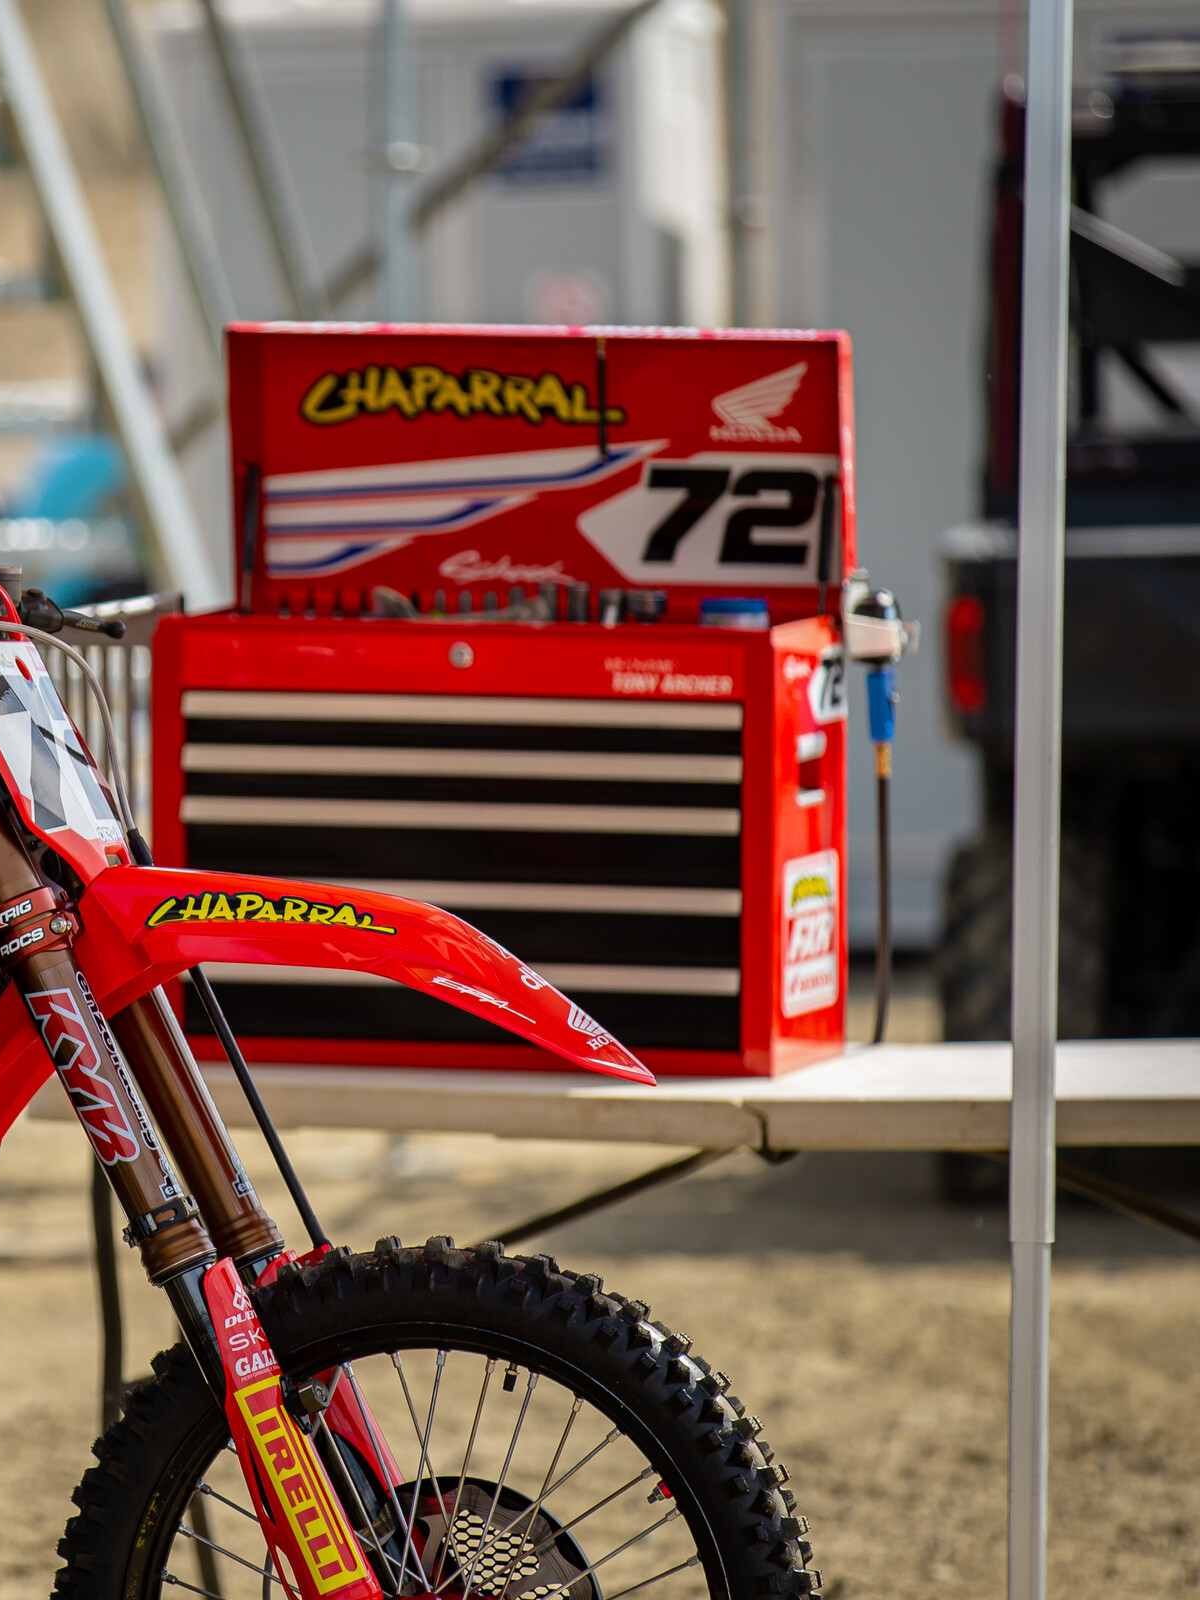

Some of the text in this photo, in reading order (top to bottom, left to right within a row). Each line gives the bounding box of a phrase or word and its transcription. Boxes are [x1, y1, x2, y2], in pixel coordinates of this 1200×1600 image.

[299, 364, 626, 424] CHAPARRAL
[642, 466, 819, 565] 72
[0, 927, 44, 957] ROCS
[147, 892, 397, 935] CHAPARRAL
[25, 987, 140, 1166] KYB
[244, 1384, 358, 1582] PIRELLI
